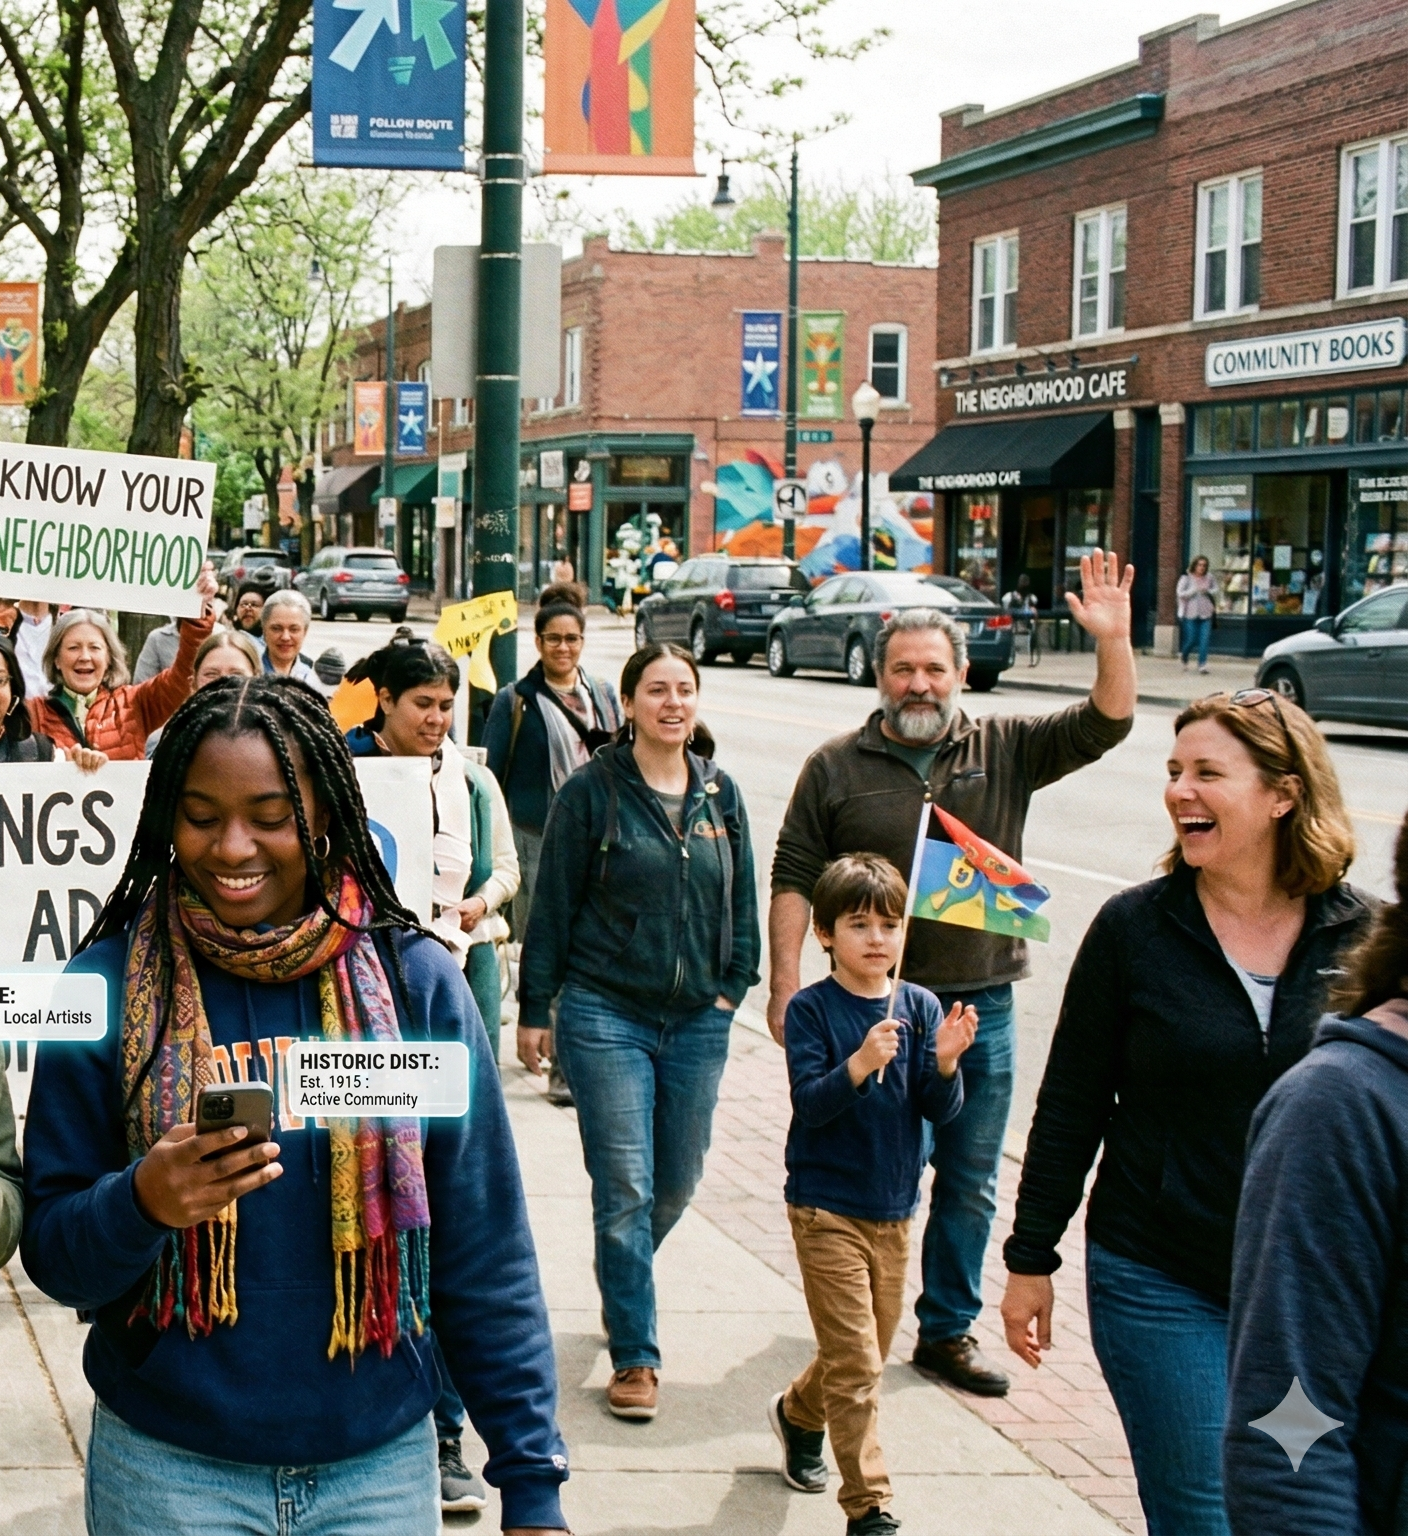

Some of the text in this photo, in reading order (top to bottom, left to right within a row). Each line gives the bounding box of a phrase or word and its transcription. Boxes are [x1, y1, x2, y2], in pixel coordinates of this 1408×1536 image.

[1213, 330, 1395, 376] COMMUNITY BOOKS
[955, 369, 1127, 414] THE NEIGHBORHOOD CAFE
[0, 458, 205, 519] KNOW YOUR
[998, 470, 1021, 486] CAFE
